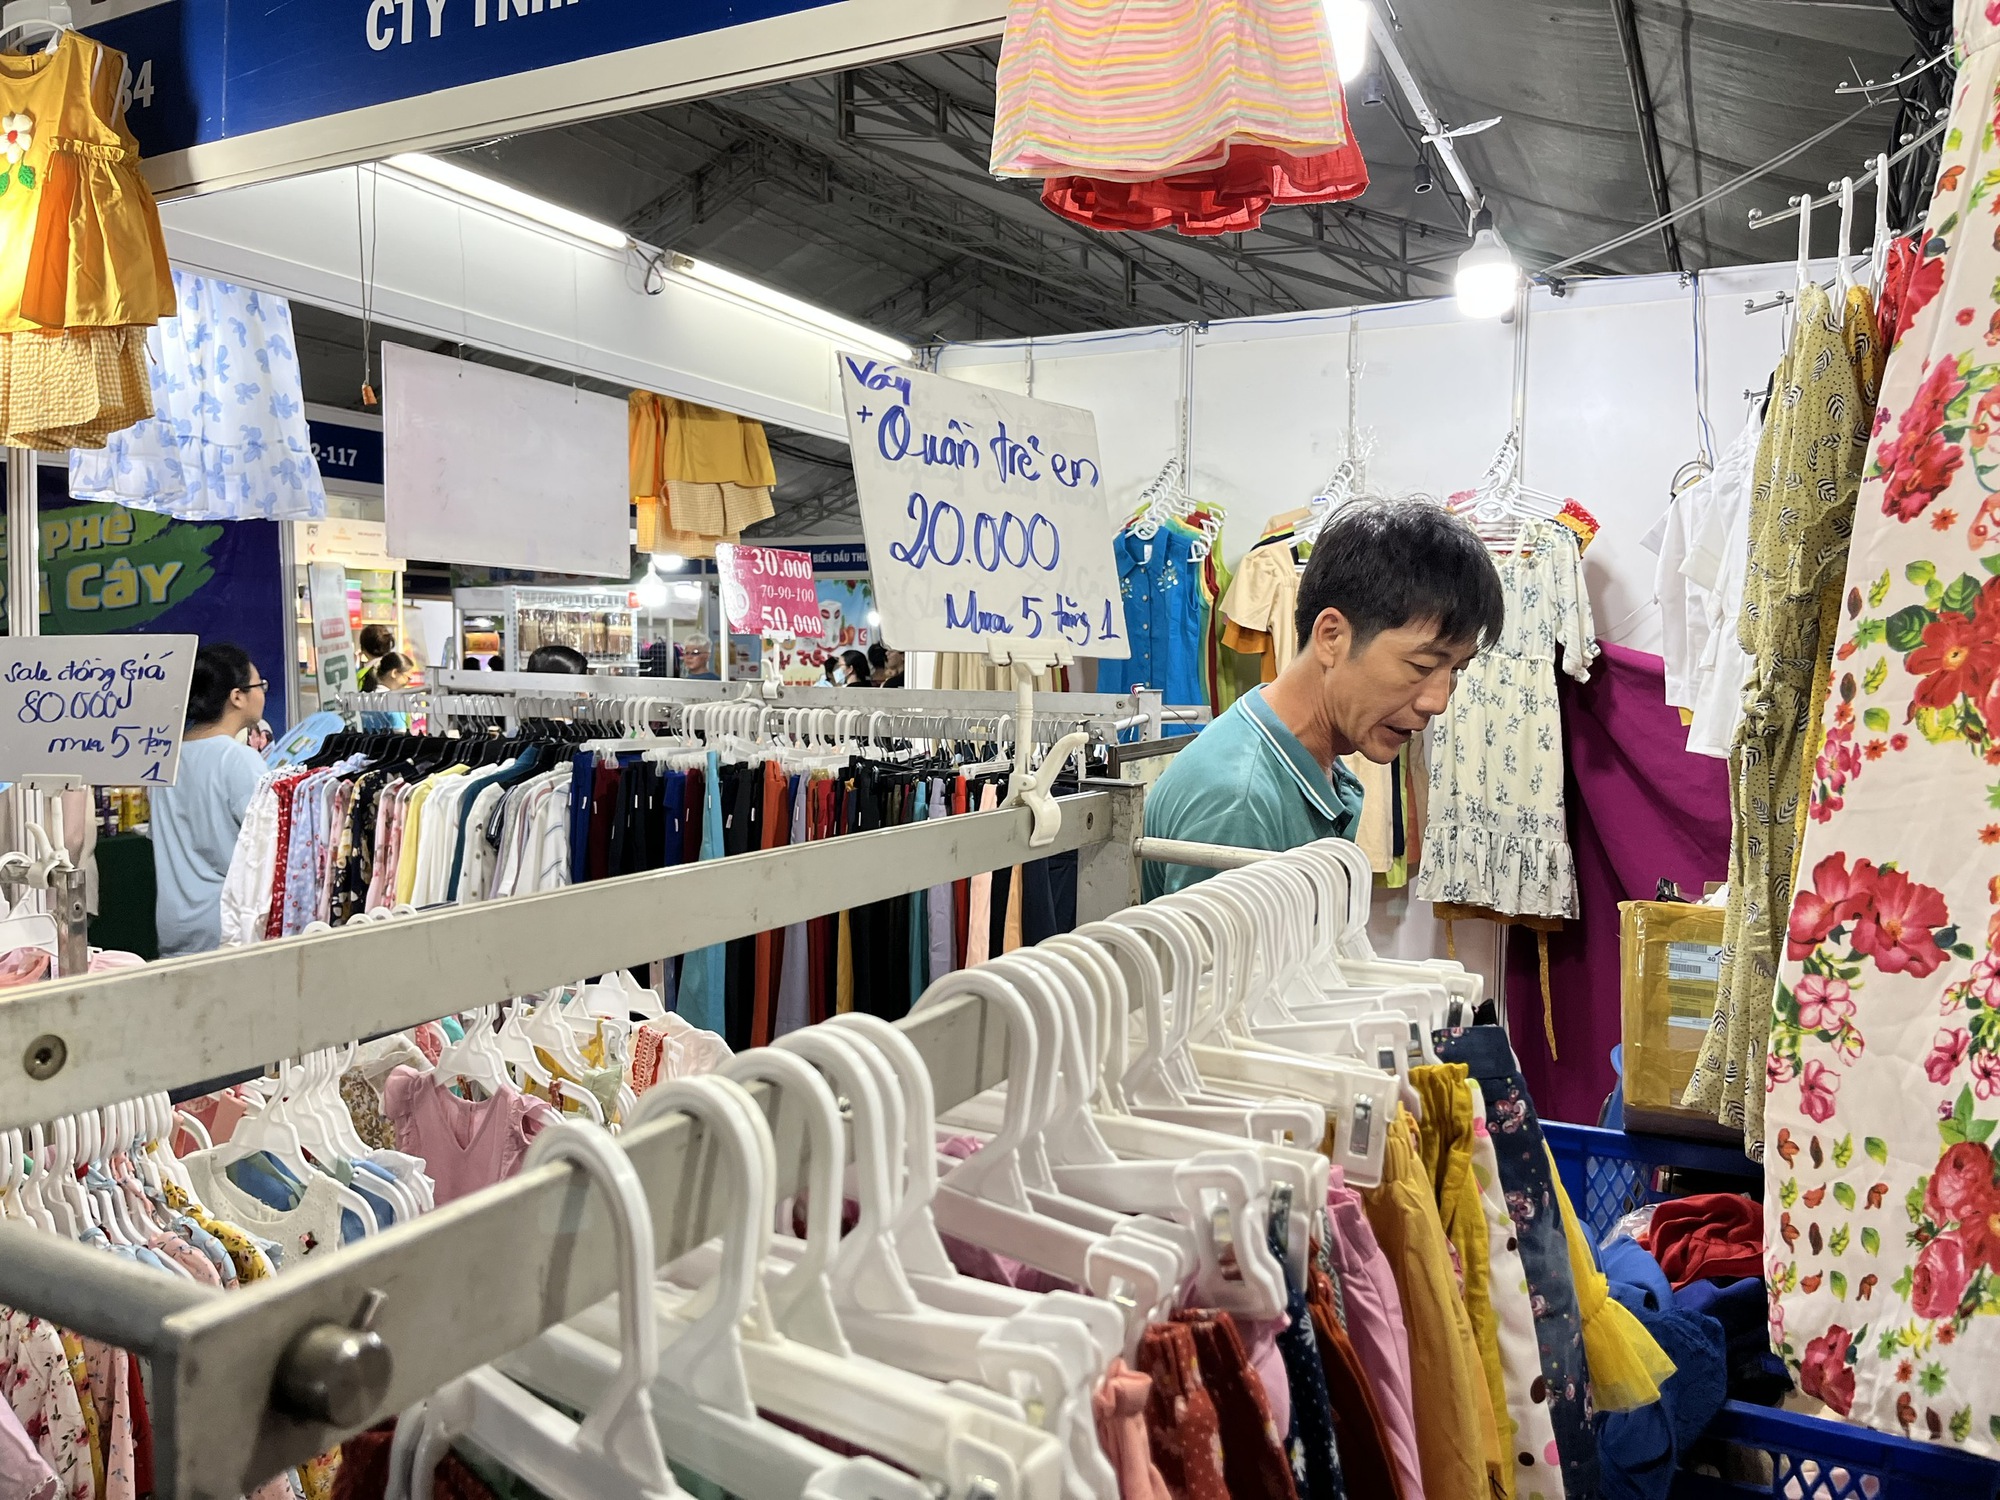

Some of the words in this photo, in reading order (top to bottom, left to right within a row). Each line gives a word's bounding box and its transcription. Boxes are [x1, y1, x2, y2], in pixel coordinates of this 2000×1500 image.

[845, 356, 911, 405] Váy
[990, 420, 1045, 484] trẻ
[890, 491, 1060, 572] 20.000
[751, 548, 812, 580] 30.000
[760, 584, 815, 603] 70-90-100
[761, 606, 822, 635] 50.000
[945, 590, 1014, 635] Mua
[1022, 596, 1043, 639] 5
[1099, 599, 1121, 640] 1
[18, 690, 118, 723] 80.000
[111, 726, 141, 758] 5
[140, 762, 168, 782] 1
